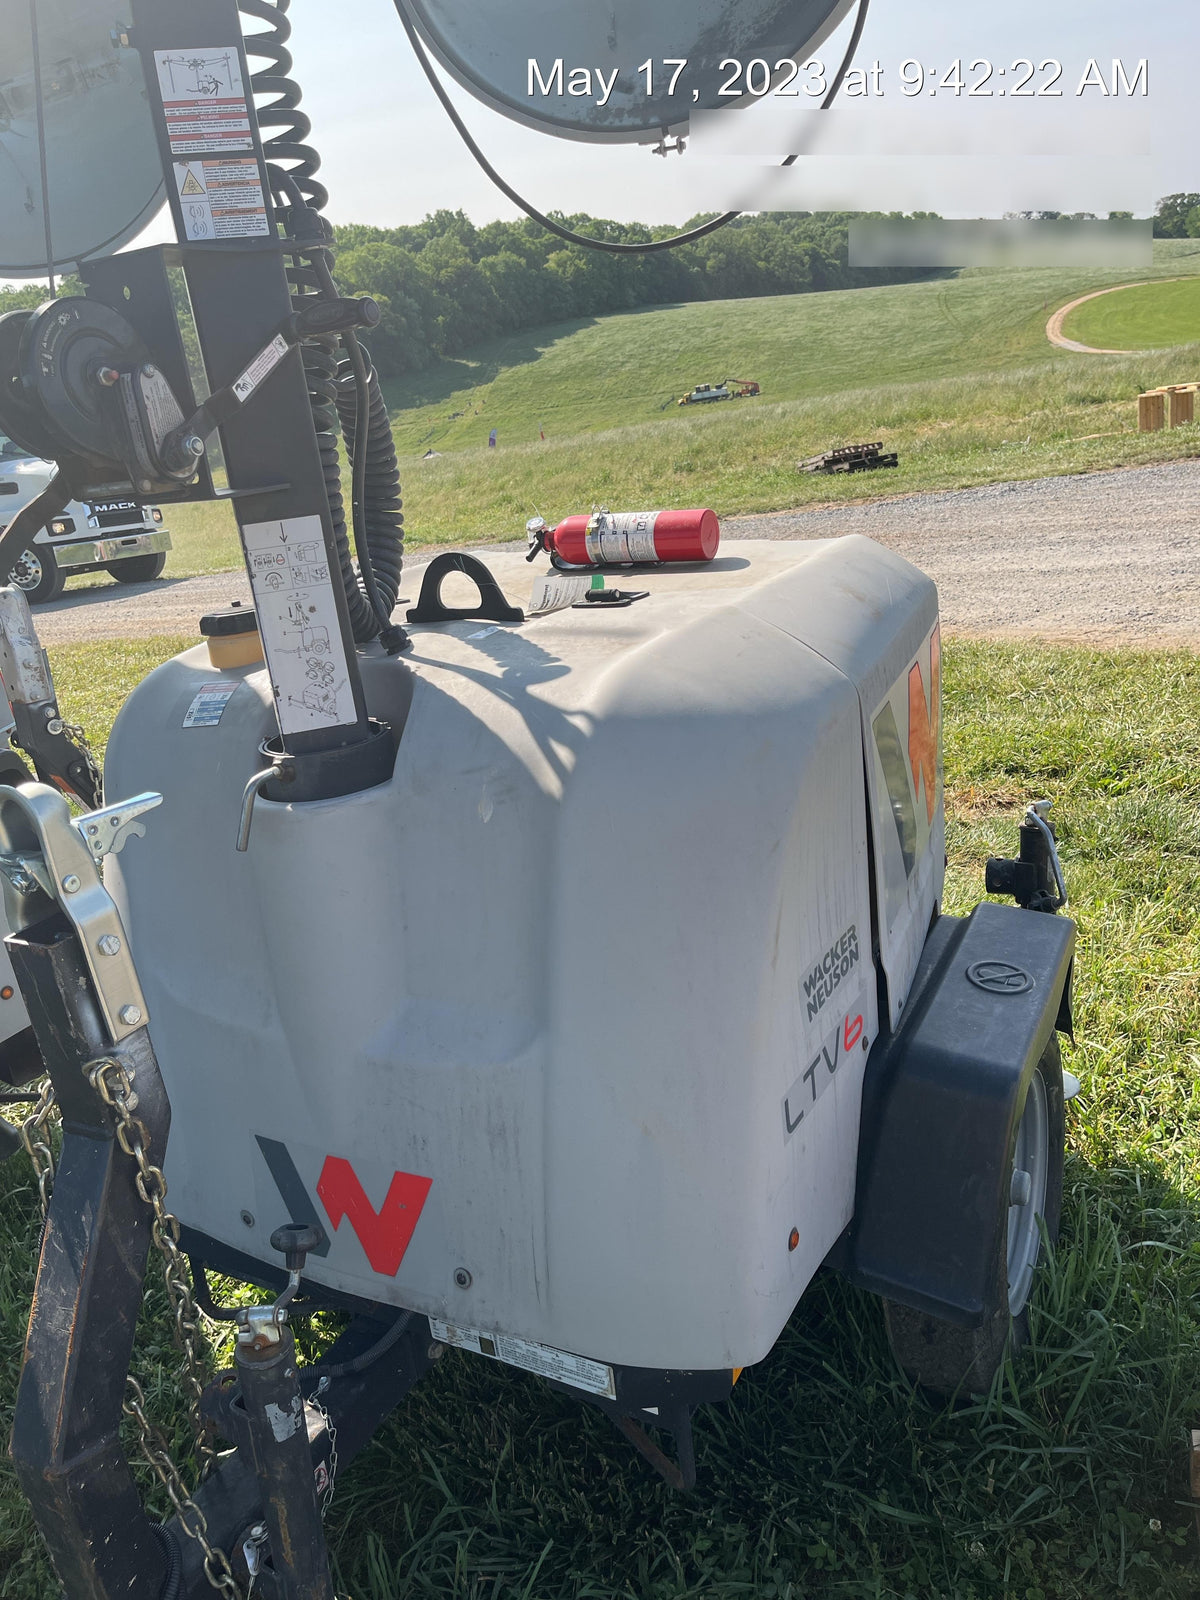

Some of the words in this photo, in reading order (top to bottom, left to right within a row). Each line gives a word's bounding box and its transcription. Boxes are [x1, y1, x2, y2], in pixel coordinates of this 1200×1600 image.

[94, 501, 136, 512] MACK
[803, 924, 858, 998] WACKER
[806, 943, 860, 1022] NEUSON
[784, 1013, 863, 1134] LTV6
